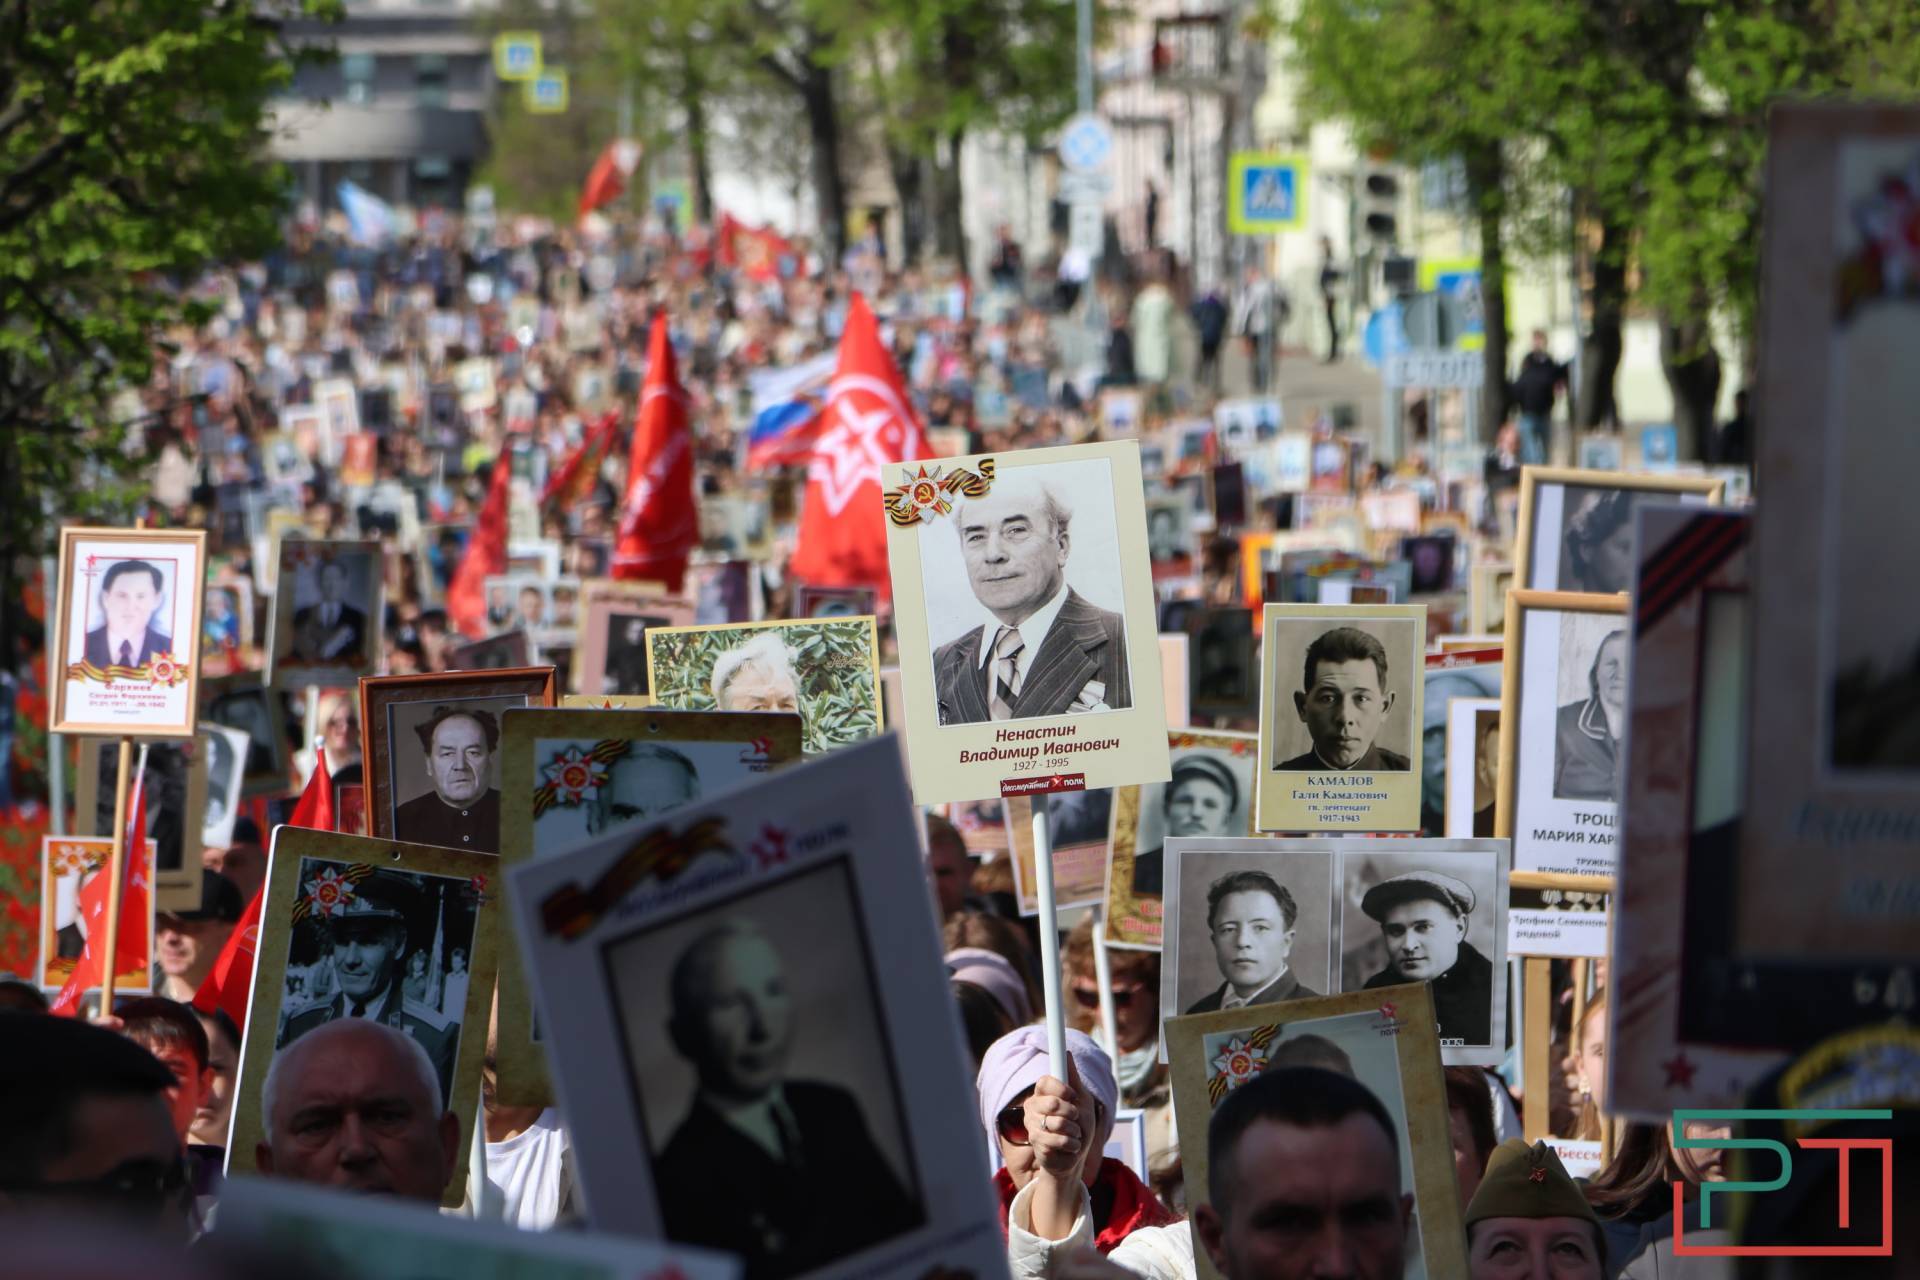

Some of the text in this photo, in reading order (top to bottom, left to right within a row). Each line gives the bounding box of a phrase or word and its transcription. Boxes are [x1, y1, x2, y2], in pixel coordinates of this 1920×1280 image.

[996, 725, 1076, 742] Ненастин
[959, 738, 1120, 763] Владимир Иванович
[1013, 761, 1037, 771] 1927
[1046, 758, 1069, 768] 1995
[1307, 776, 1374, 786] КАМАЛОВ
[1292, 790, 1388, 800] Гали Камалович
[1319, 814, 1361, 823] 1917-1943
[1573, 812, 1616, 828] ТРОЦ
[1532, 829, 1616, 845] МАРИЯ ХАР
[1576, 858, 1615, 866] ТРУЖЕН
